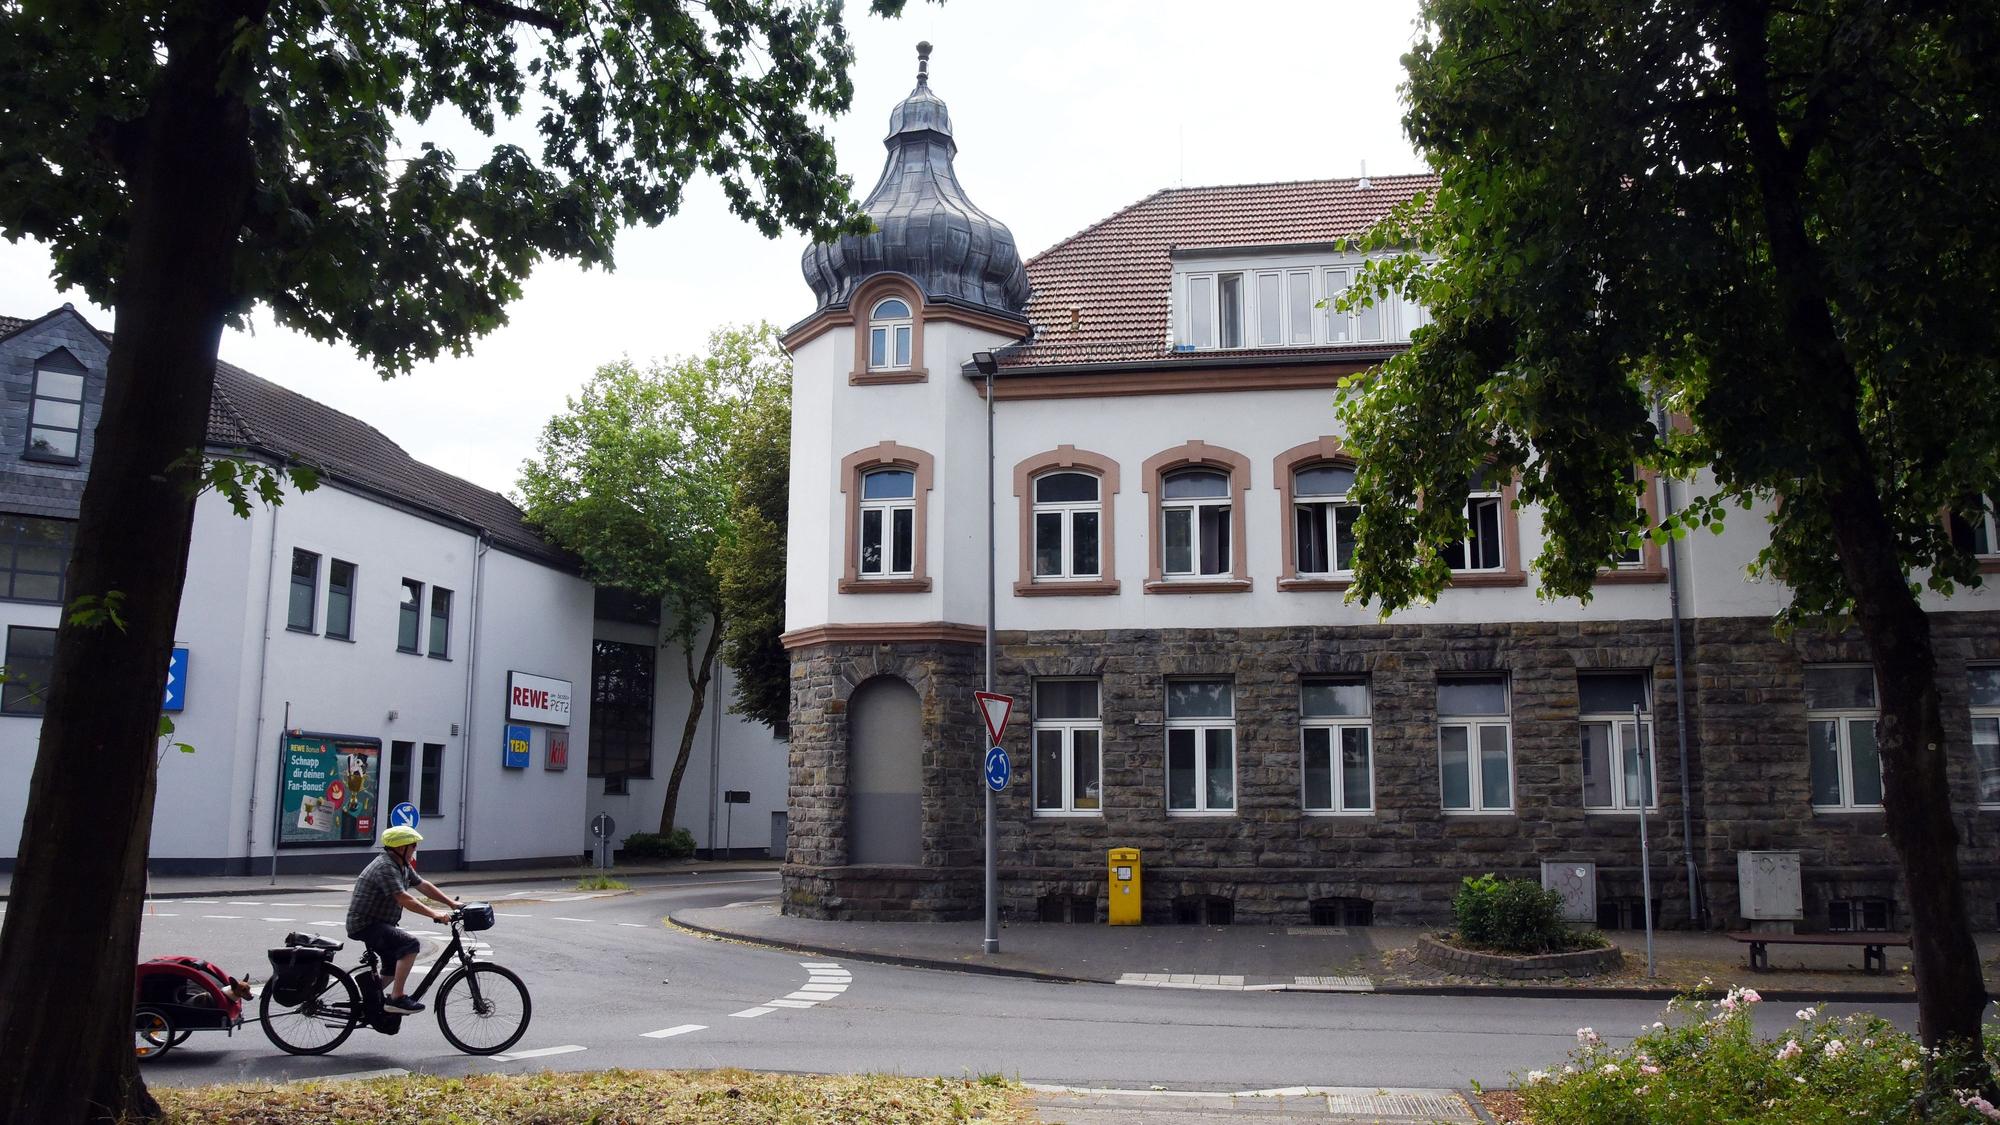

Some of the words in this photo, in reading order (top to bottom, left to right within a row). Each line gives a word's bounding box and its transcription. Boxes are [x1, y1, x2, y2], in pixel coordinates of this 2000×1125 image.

[513, 686, 548, 709] REWE
[551, 700, 569, 713] PETZ
[291, 744, 305, 752] REWE
[305, 745, 320, 753] Bonus
[511, 739, 528, 753] TEDi
[291, 755, 319, 768] Schnapp
[293, 767, 303, 778] dir
[303, 768, 325, 779] deinen
